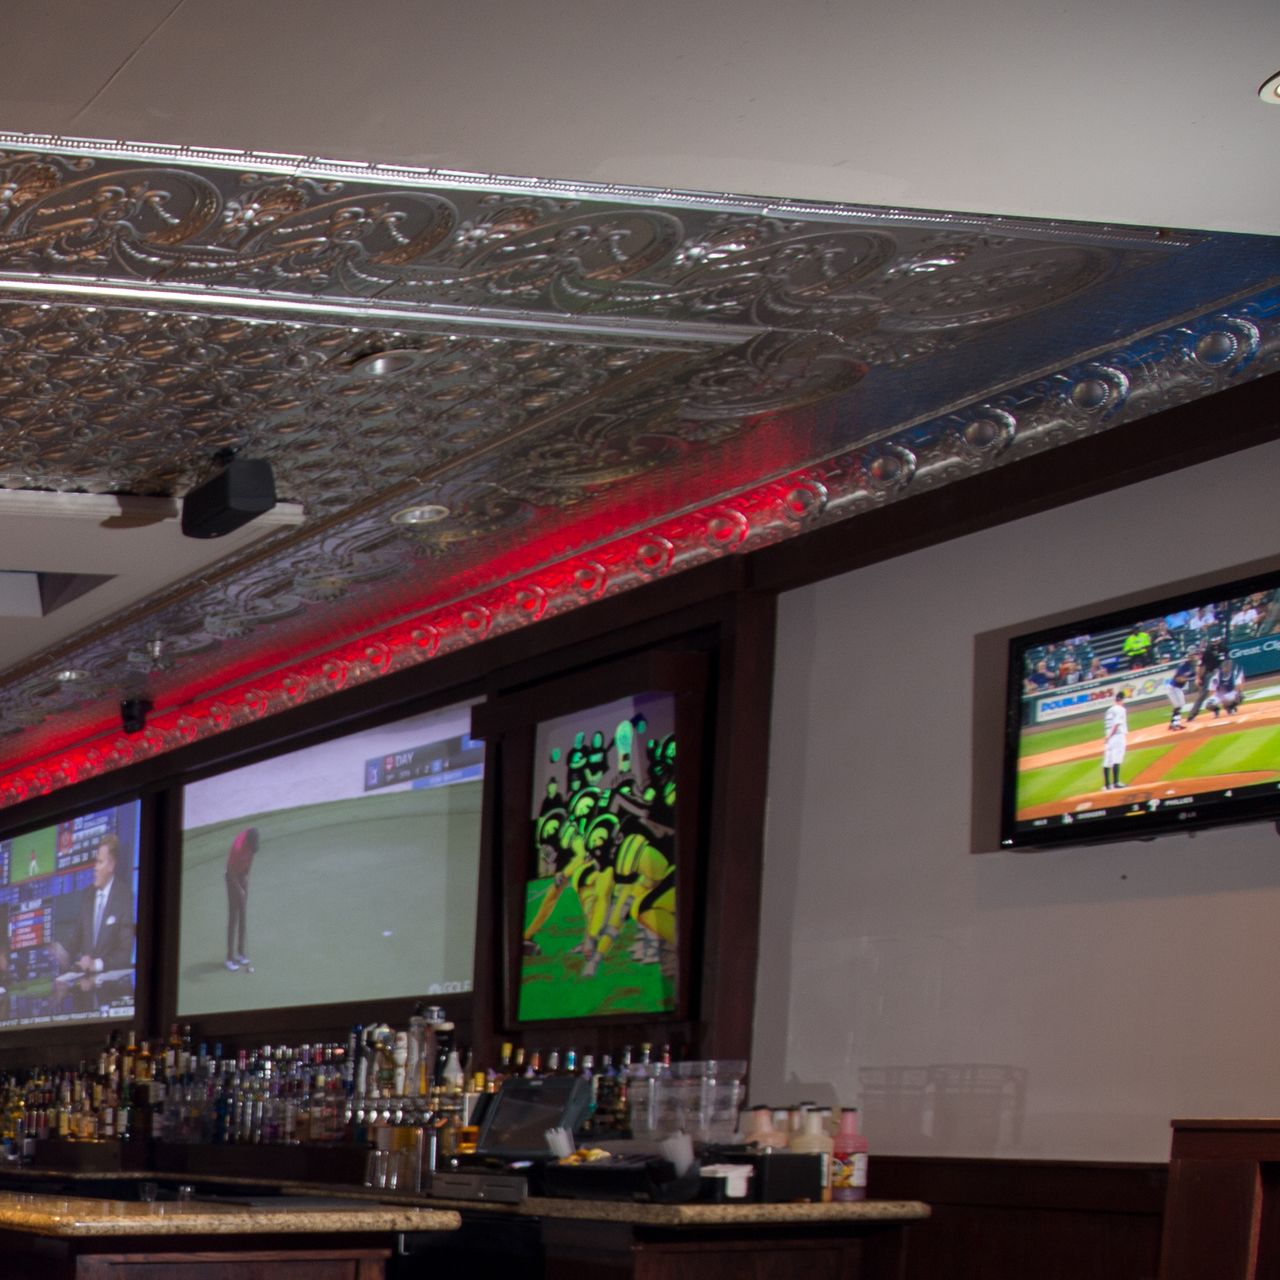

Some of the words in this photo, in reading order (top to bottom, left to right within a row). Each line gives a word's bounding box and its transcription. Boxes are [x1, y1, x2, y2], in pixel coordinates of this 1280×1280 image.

[1229, 645, 1262, 659] Great
[395, 752, 415, 768] DAY
[444, 980, 472, 992] GOLF
